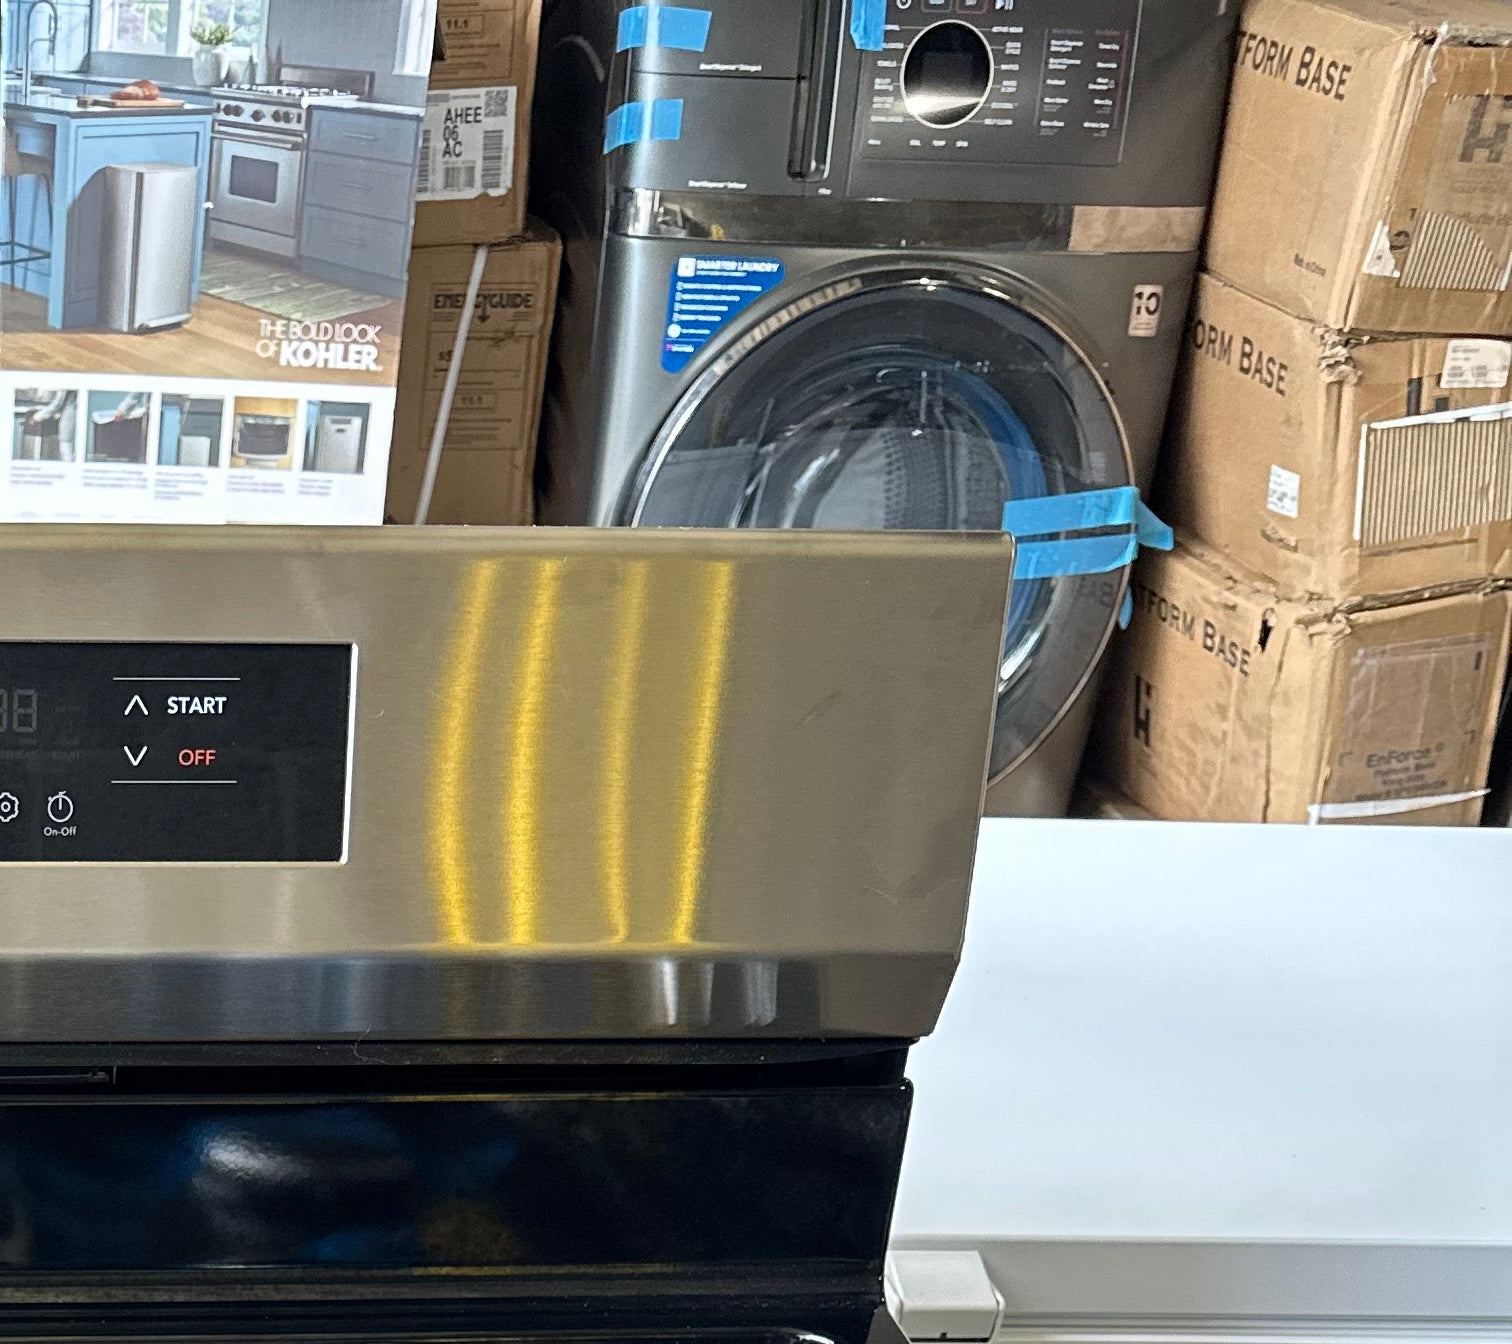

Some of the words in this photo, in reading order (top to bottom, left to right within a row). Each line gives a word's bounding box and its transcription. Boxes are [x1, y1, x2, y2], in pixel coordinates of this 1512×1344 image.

[443, 106, 483, 124] AHEE
[443, 125, 459, 142] 06
[442, 141, 463, 158] AC
[1136, 292, 1160, 315] 10
[259, 319, 286, 339] THE
[289, 320, 334, 341] BOLD
[335, 323, 382, 344] LOOK
[255, 339, 278, 358] OF
[280, 340, 378, 371] KOHLER
[167, 696, 227, 714] START
[178, 749, 217, 766] OFF
[43, 826, 77, 837] On-Off
